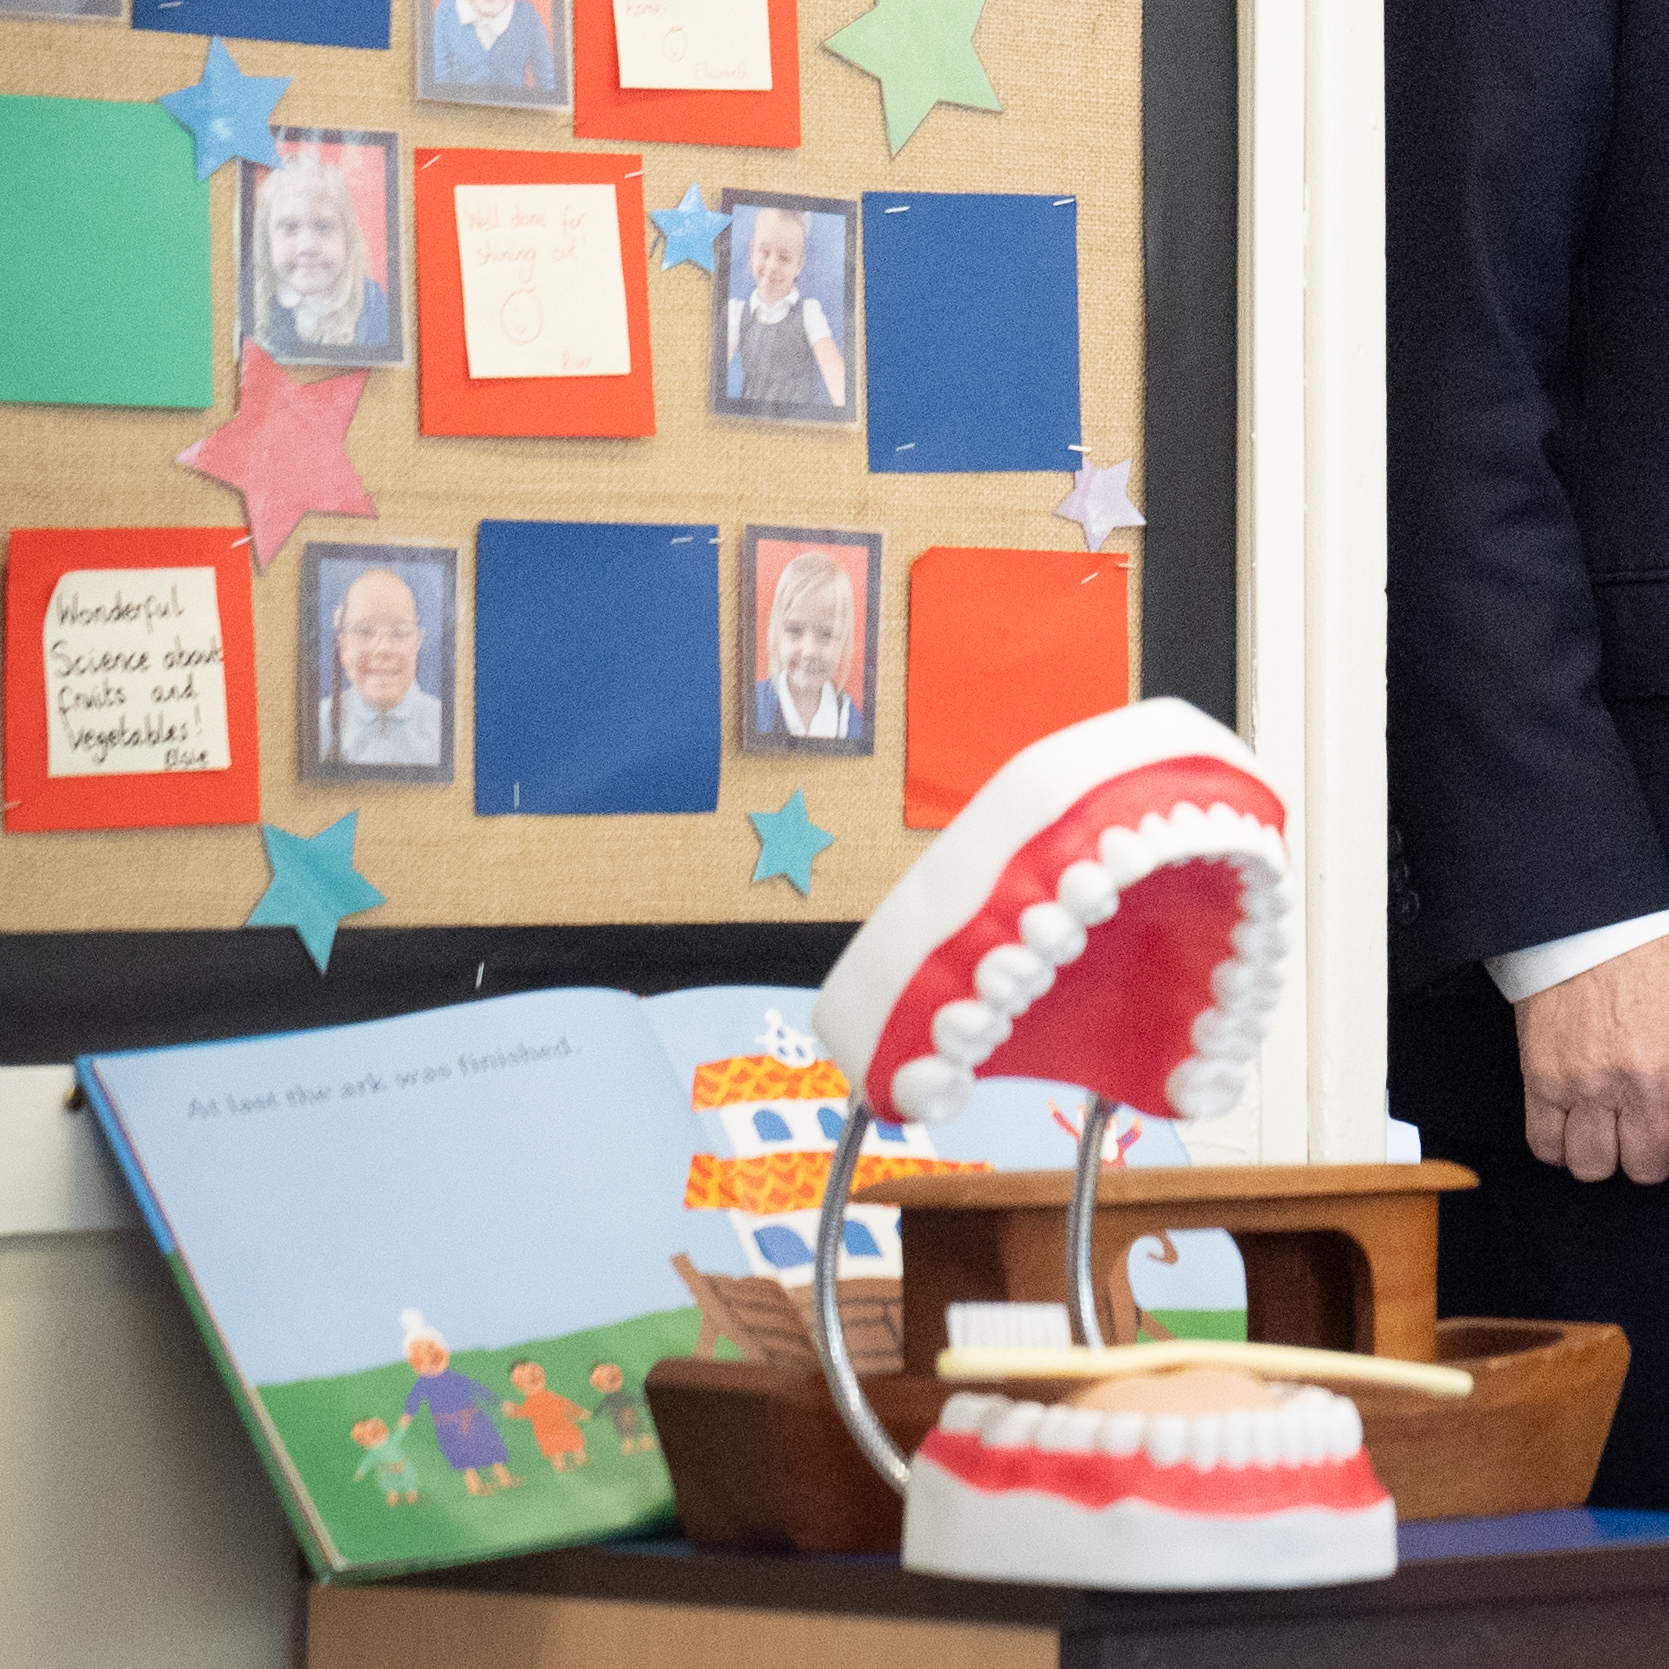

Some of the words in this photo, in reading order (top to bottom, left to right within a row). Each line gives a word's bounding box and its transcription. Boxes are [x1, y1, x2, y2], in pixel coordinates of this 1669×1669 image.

[511, 203, 548, 228] done
[561, 205, 586, 235] for
[56, 584, 184, 635] Wonderful
[51, 639, 150, 678] Science
[164, 635, 223, 670] about
[152, 672, 199, 704] and
[340, 1071, 385, 1099] ark
[395, 1063, 453, 1089] was
